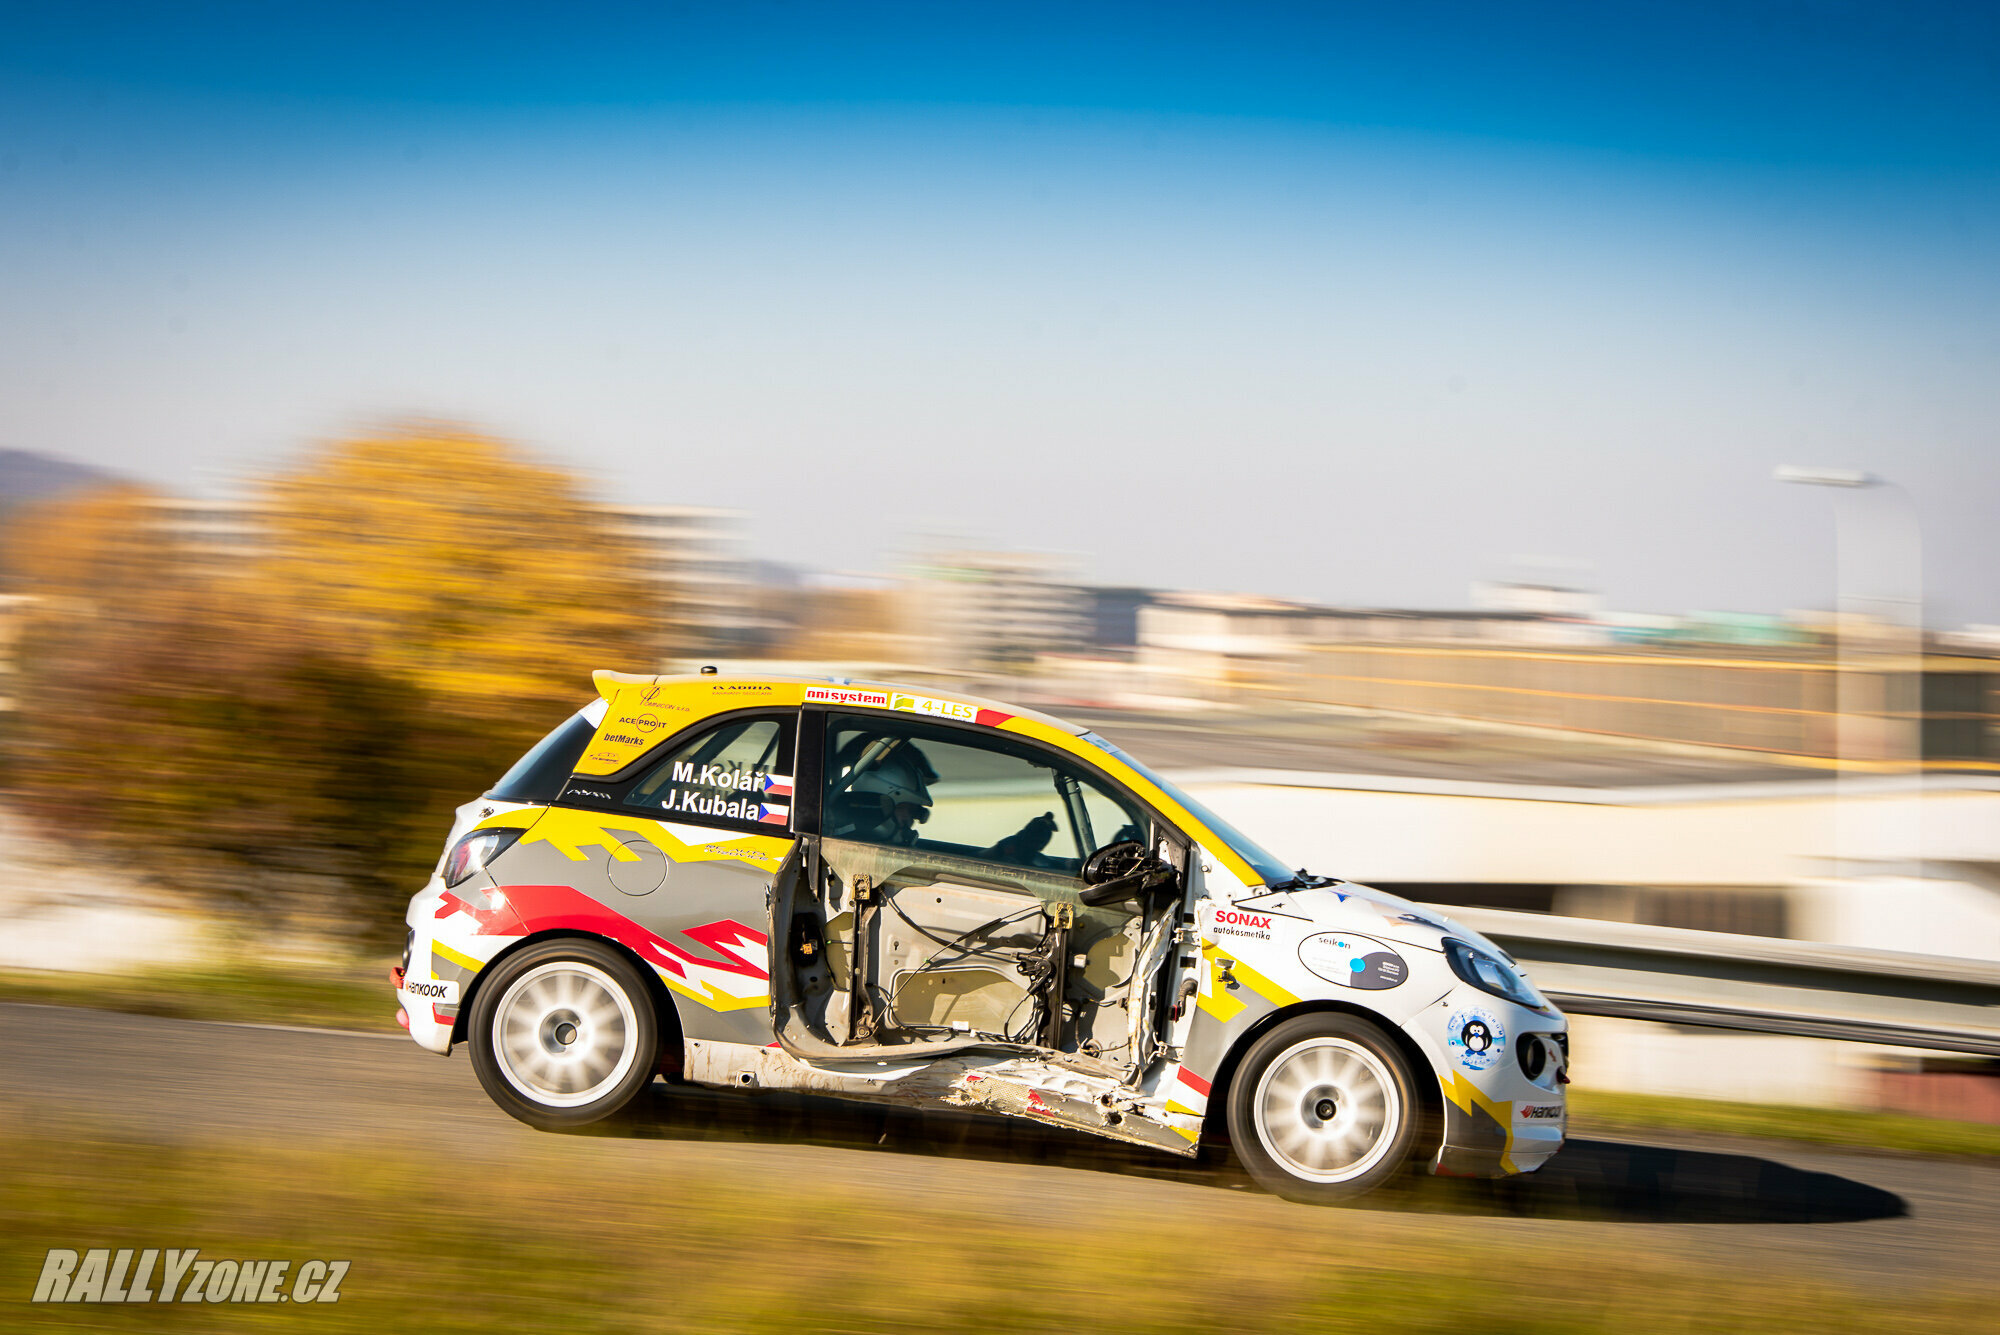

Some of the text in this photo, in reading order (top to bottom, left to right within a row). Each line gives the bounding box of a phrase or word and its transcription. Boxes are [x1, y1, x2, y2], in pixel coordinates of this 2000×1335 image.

[921, 700, 973, 719] 4-LES
[603, 732, 645, 746] betMarks
[671, 760, 765, 793] M.Kolář
[661, 788, 760, 821] J.Kubala
[1215, 910, 1272, 930] SONAX
[1213, 926, 1271, 941] autokosmetika
